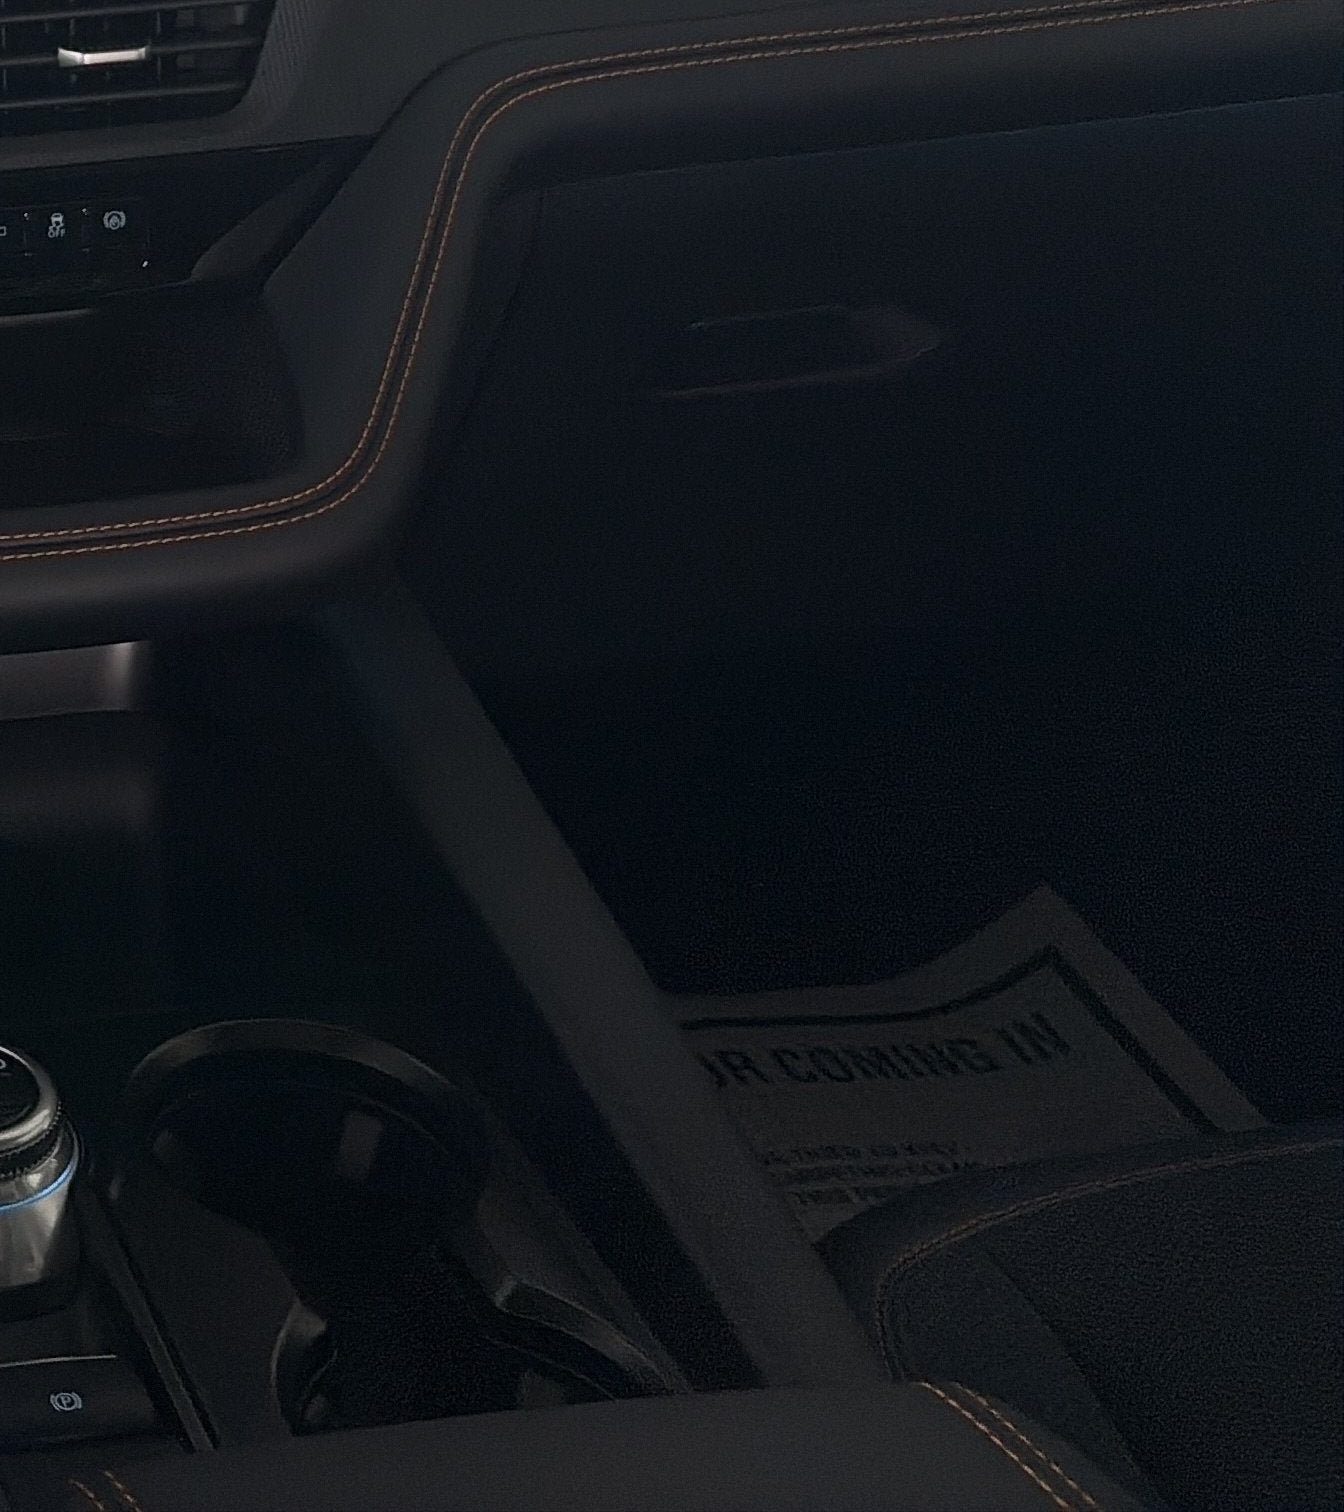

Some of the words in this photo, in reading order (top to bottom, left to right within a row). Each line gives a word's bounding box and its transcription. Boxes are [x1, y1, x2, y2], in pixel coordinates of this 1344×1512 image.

[47, 226, 66, 239] OFF
[770, 1037, 1003, 1084] COMING
[992, 1011, 1071, 1064] IN
